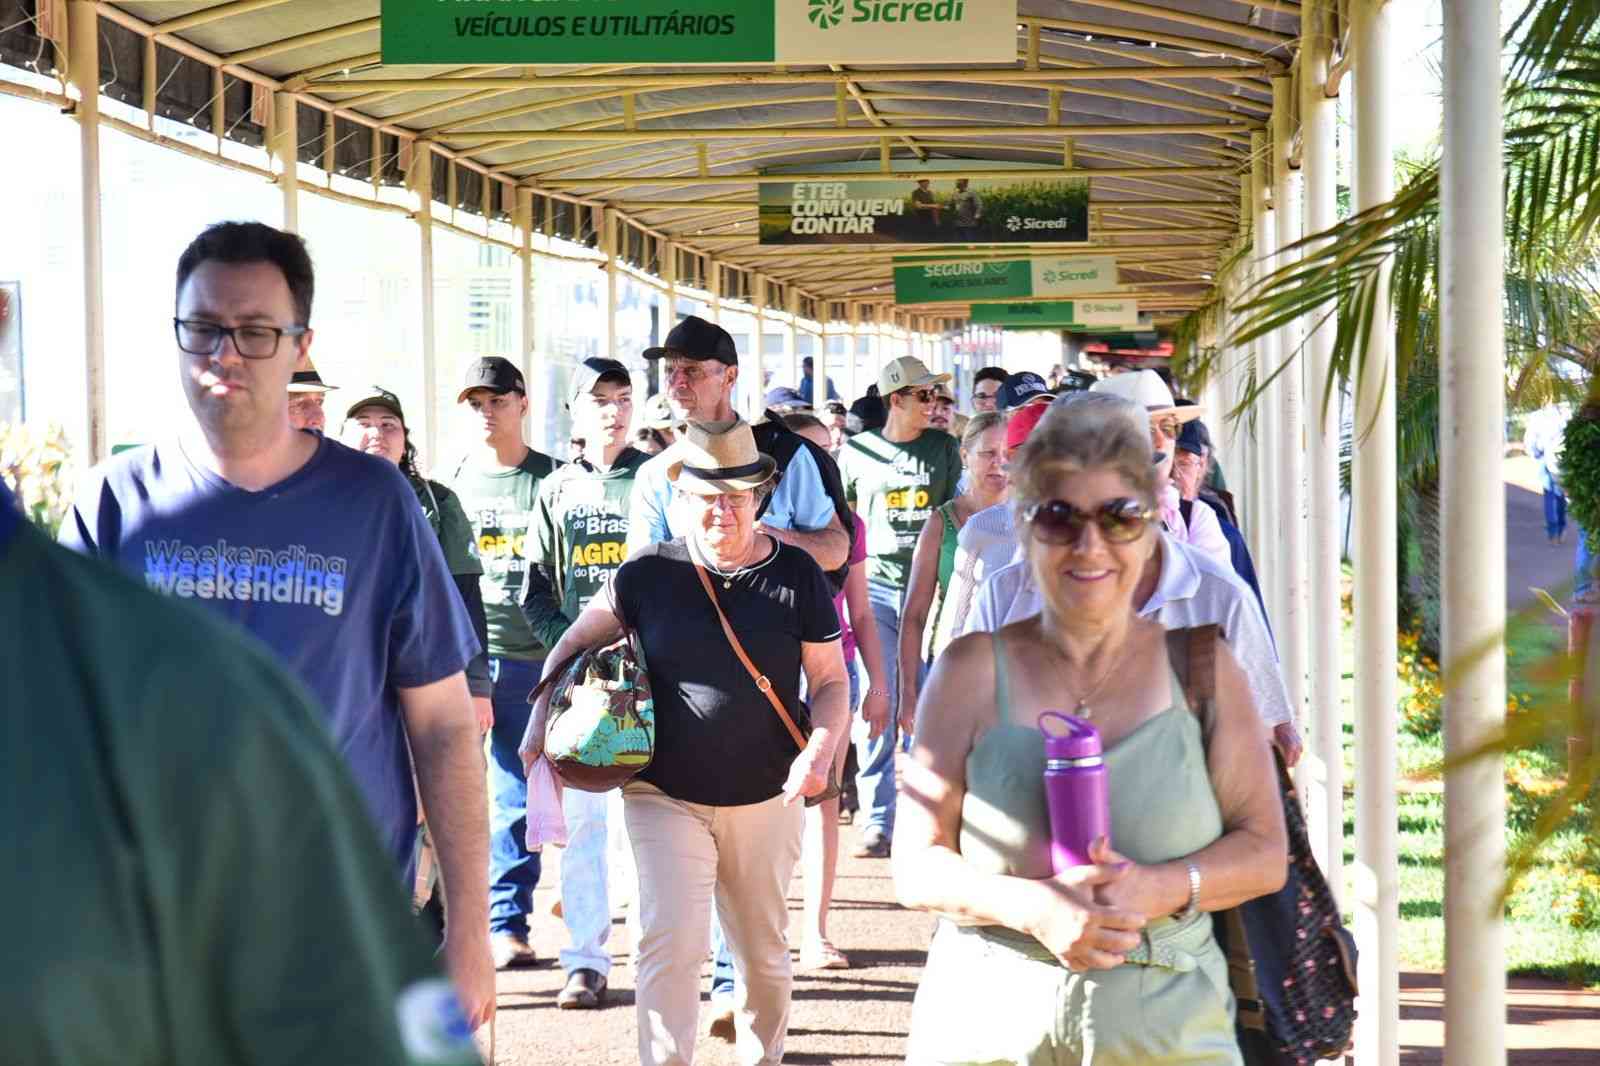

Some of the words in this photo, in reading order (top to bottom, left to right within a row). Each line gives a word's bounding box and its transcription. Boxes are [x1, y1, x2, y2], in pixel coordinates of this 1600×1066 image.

[852, 0, 964, 22] Sicredi
[455, 11, 566, 36] VEÍCULOS
[572, 16, 586, 36] E
[590, 9, 735, 36] UTILITÁRIOS
[791, 216, 875, 234] CONTAR
[1023, 217, 1067, 229] Sicredi
[923, 263, 985, 277] SEGURO
[1058, 269, 1098, 281] Sicredi
[586, 516, 629, 535] Bras
[588, 565, 618, 583] Par
[143, 569, 344, 616] Weekending
